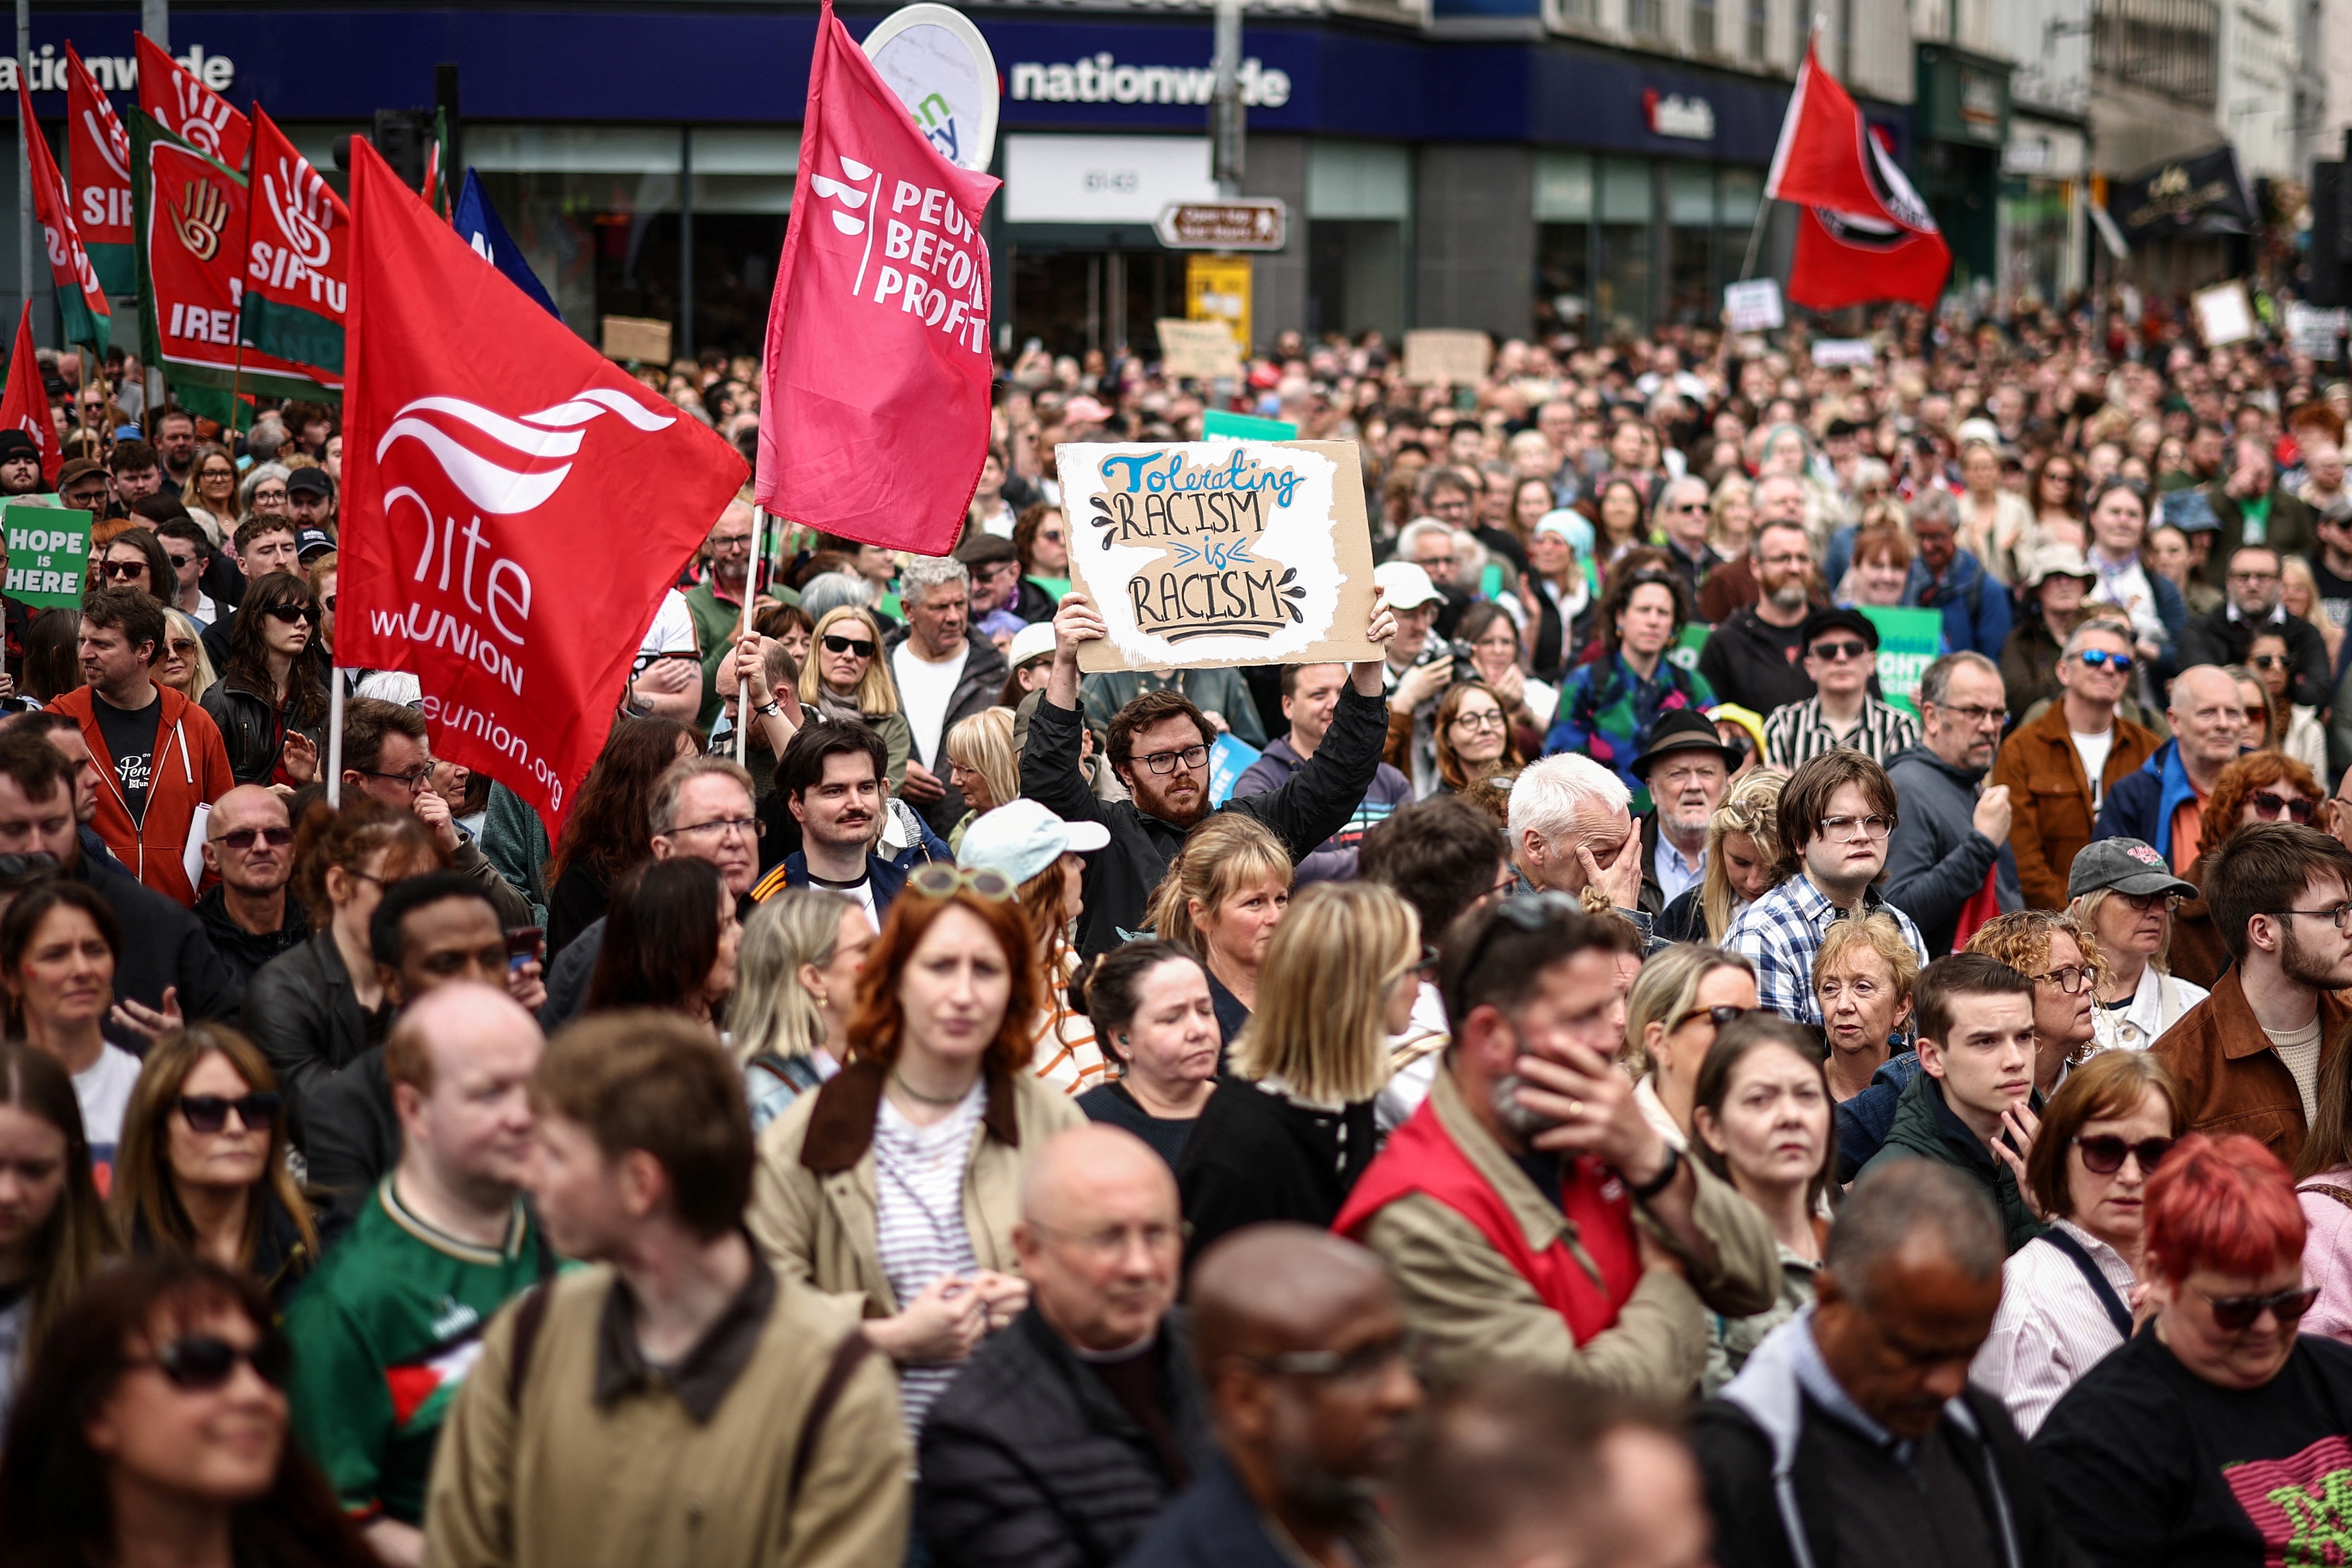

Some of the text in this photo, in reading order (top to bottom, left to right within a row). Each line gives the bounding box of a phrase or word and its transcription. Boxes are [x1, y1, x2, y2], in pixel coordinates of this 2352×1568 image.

[249, 241, 347, 314] SIPTU
[1102, 449, 1308, 508] Tolerating
[9, 528, 84, 554] HOPE
[1113, 491, 1264, 540] RACISM
[37, 554, 51, 567] IS
[1203, 535, 1226, 570] is
[5, 568, 78, 594] HERE
[1128, 569, 1286, 625] RACISM
[409, 602, 523, 696] UNION
[422, 695, 563, 811] eunion.org
